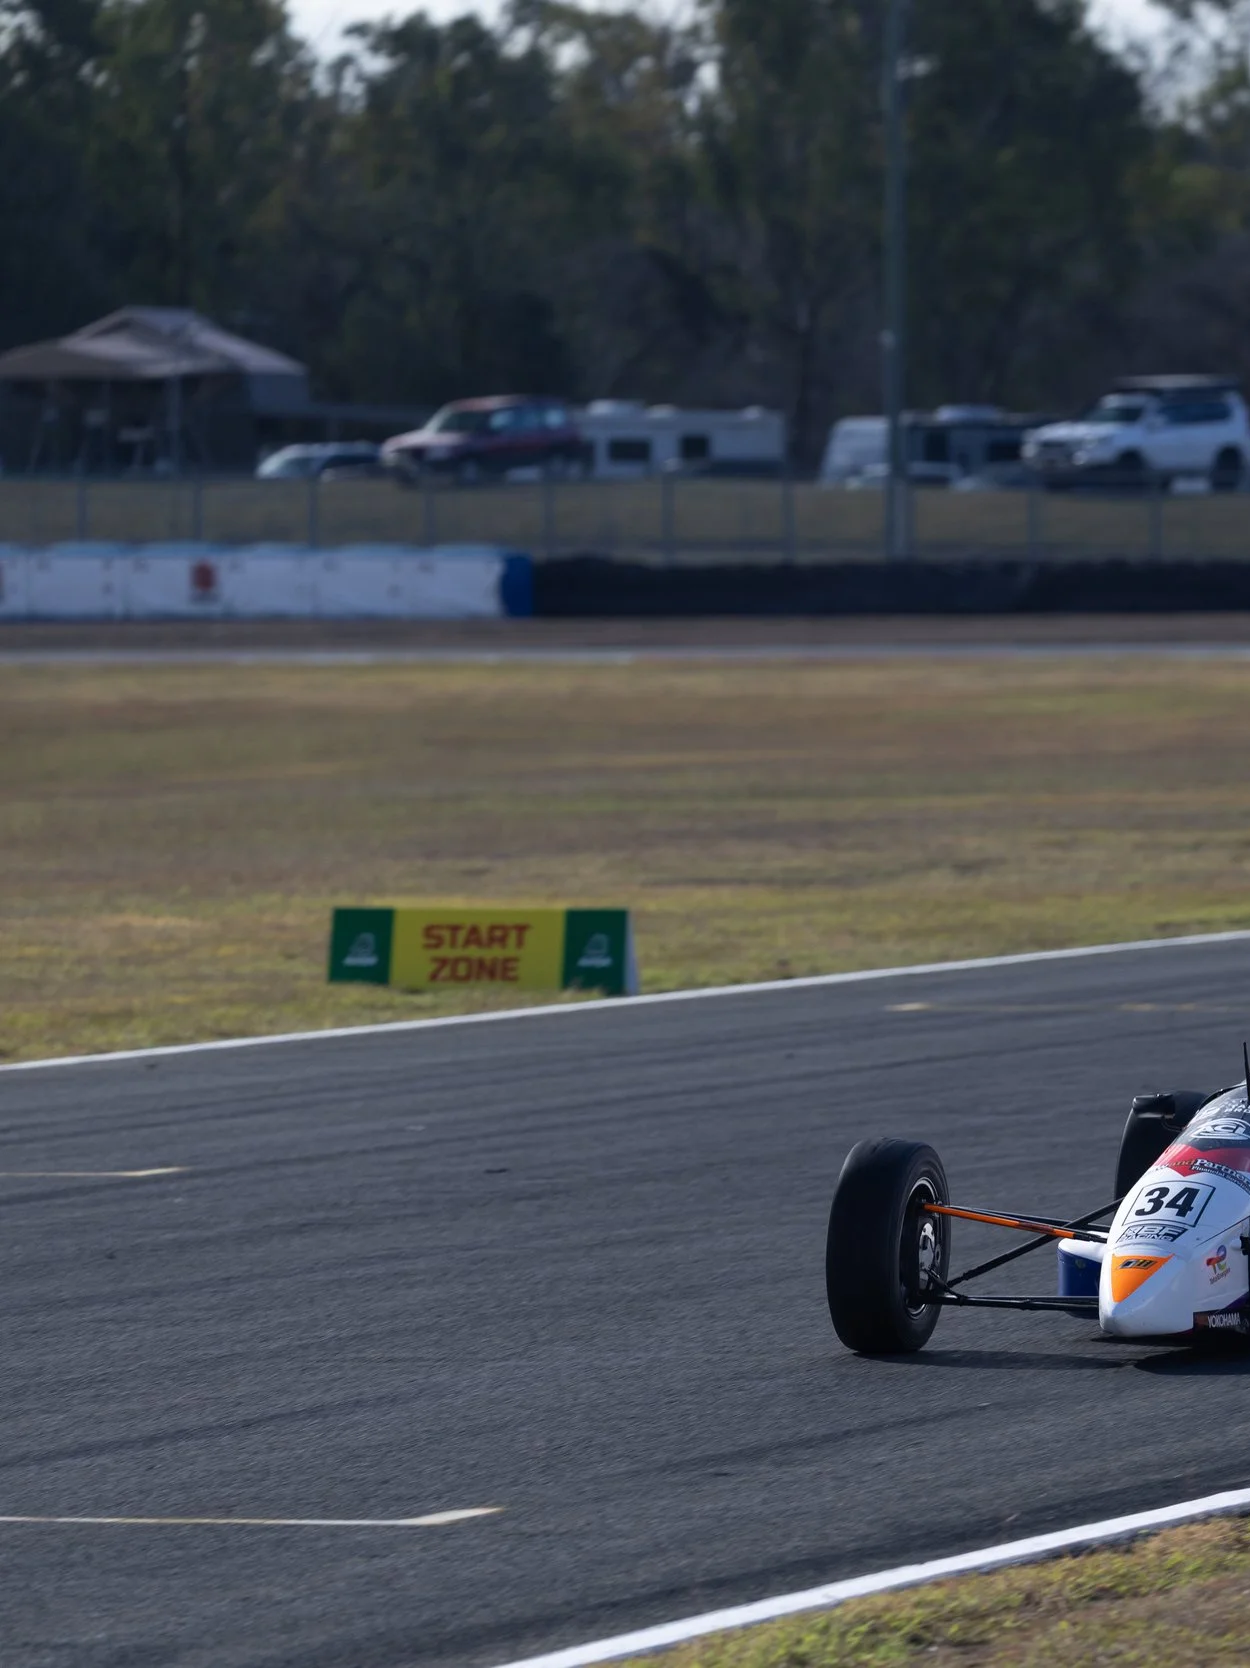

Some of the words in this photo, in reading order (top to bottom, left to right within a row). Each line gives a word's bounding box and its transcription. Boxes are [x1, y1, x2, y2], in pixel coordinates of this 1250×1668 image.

[422, 923, 531, 950] START
[429, 956, 520, 983] ZONE
[1134, 1186, 1200, 1218] 34
[1207, 1312, 1241, 1328] YOKOHAMA
